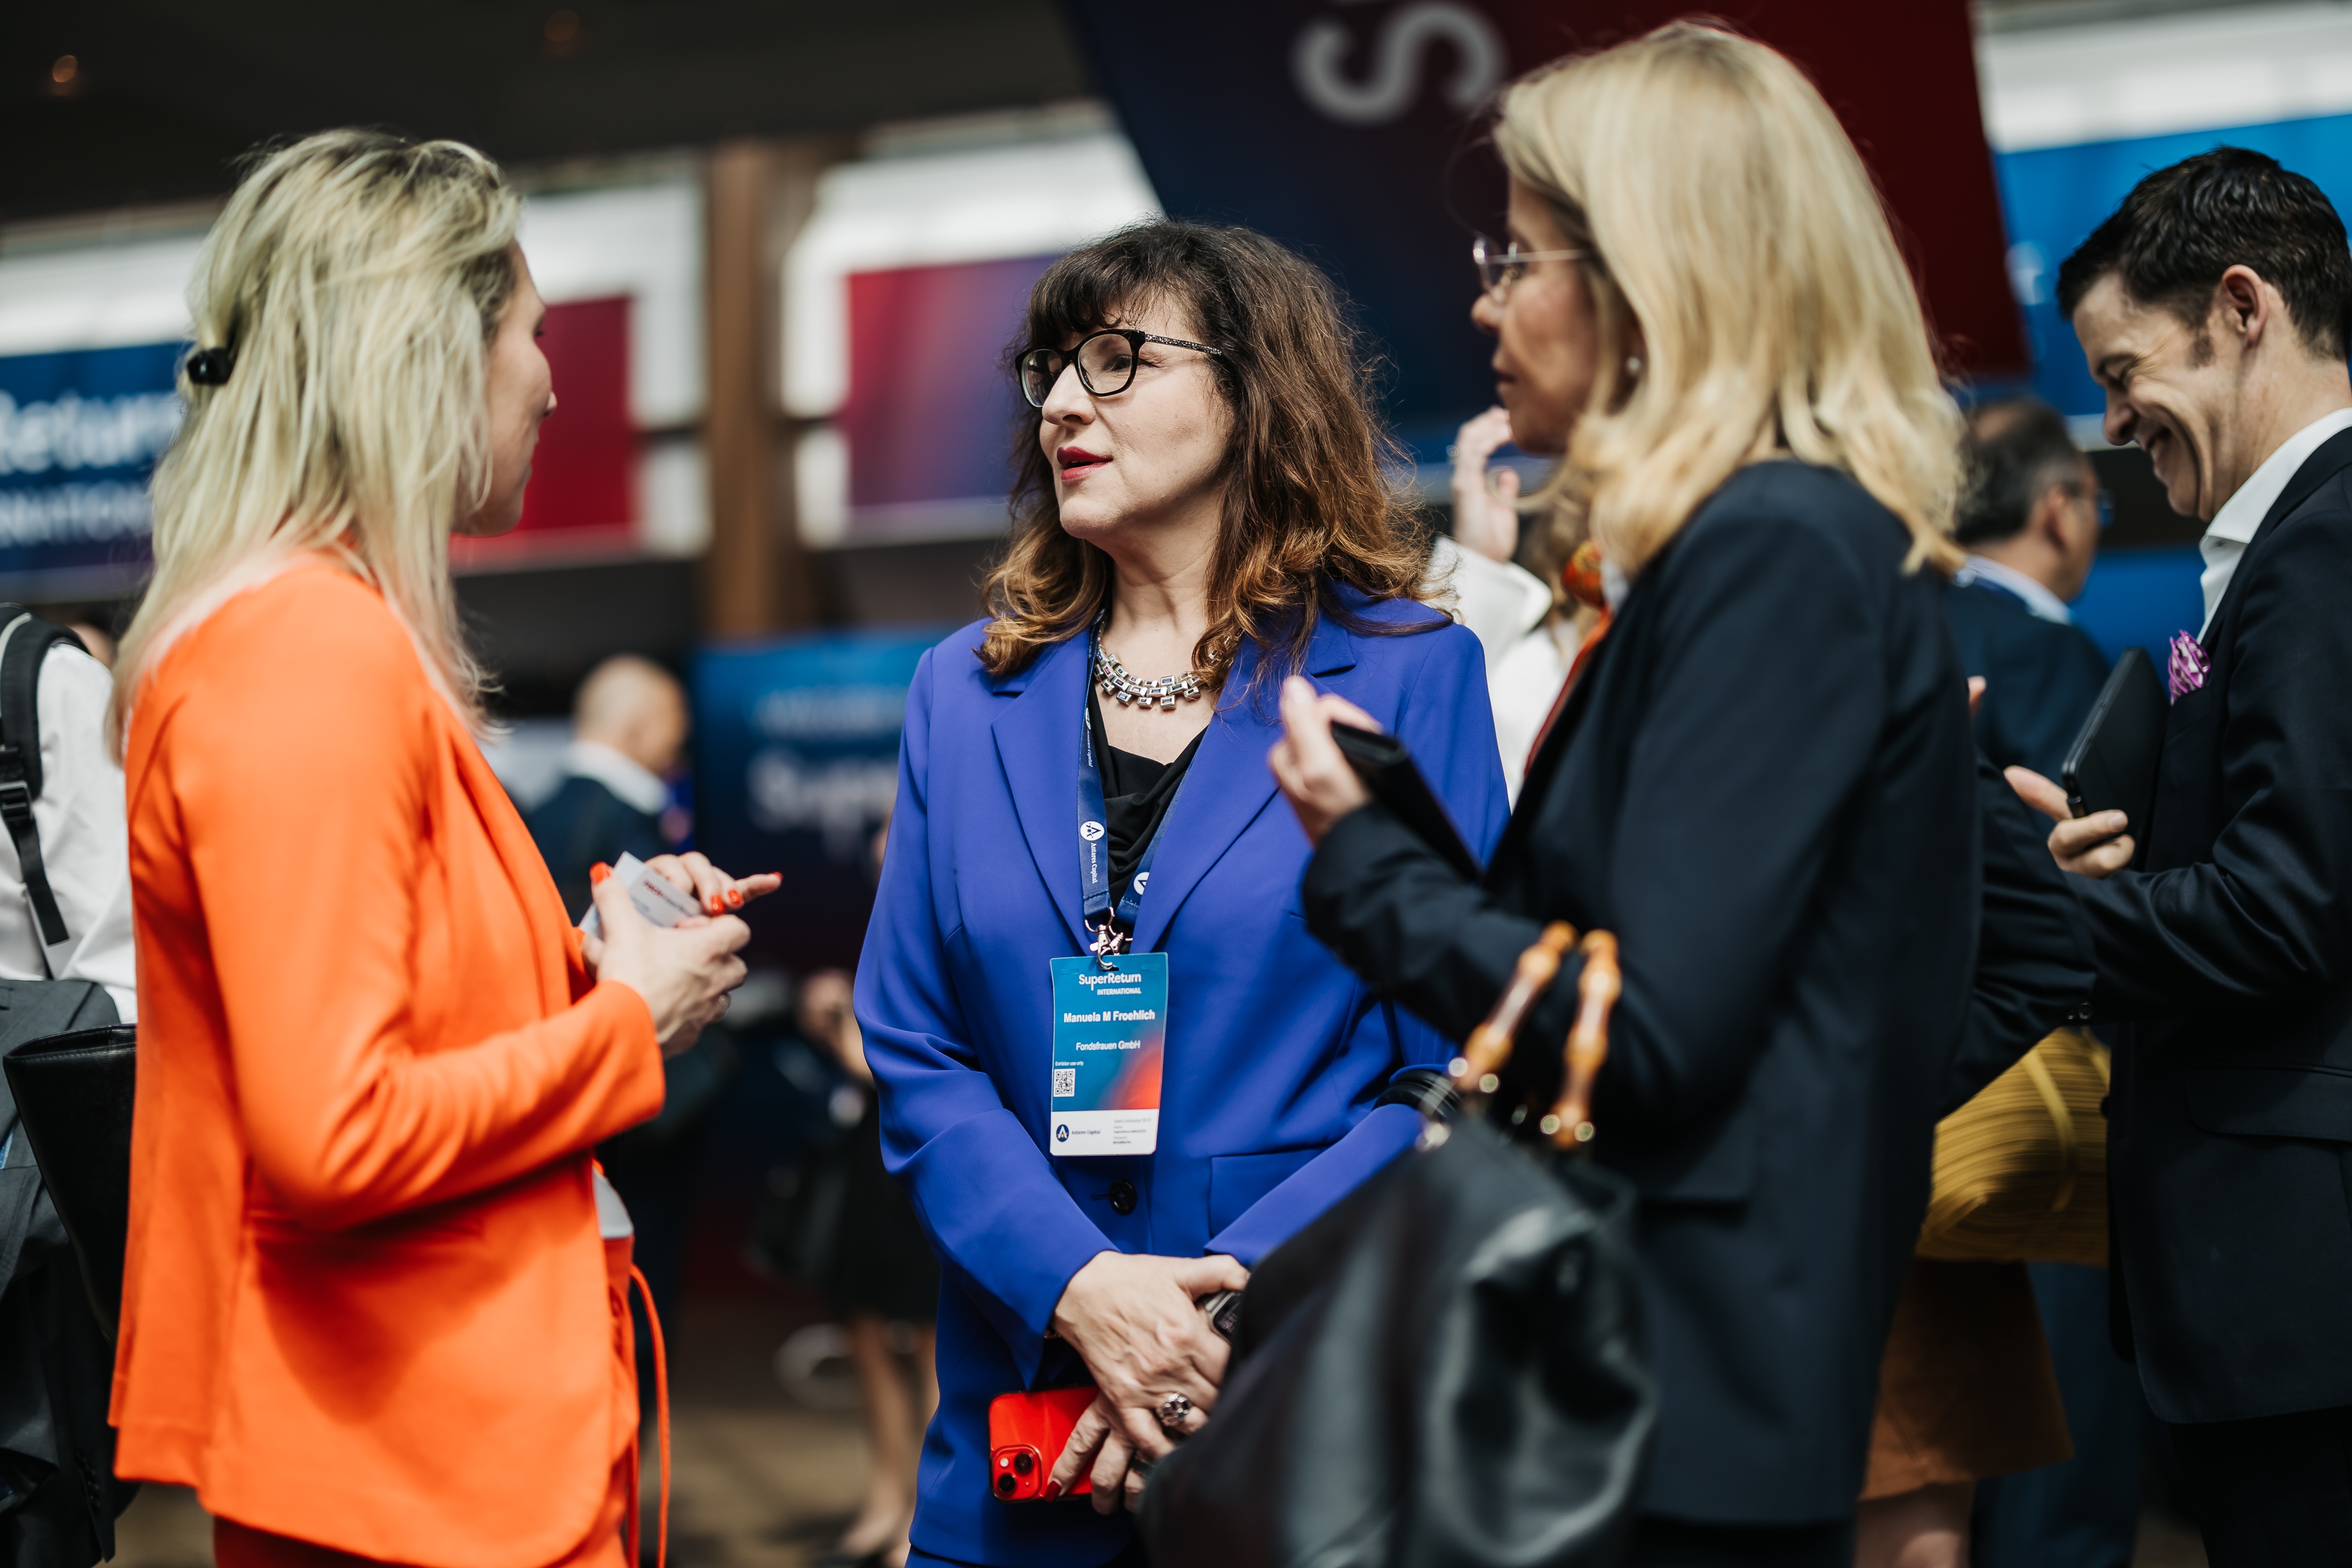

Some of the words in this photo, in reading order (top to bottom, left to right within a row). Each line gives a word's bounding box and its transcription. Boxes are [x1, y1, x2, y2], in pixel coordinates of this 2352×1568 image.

[1290, 1, 1505, 124] S
[1079, 972, 1142, 991] SuperReturn
[1097, 987, 1142, 995] INTERNATIONAL
[1064, 1011, 1101, 1023] Manuela
[1103, 1011, 1111, 1021] M
[1112, 1009, 1155, 1021] Froehlich
[1118, 1040, 1141, 1050] GmbH
